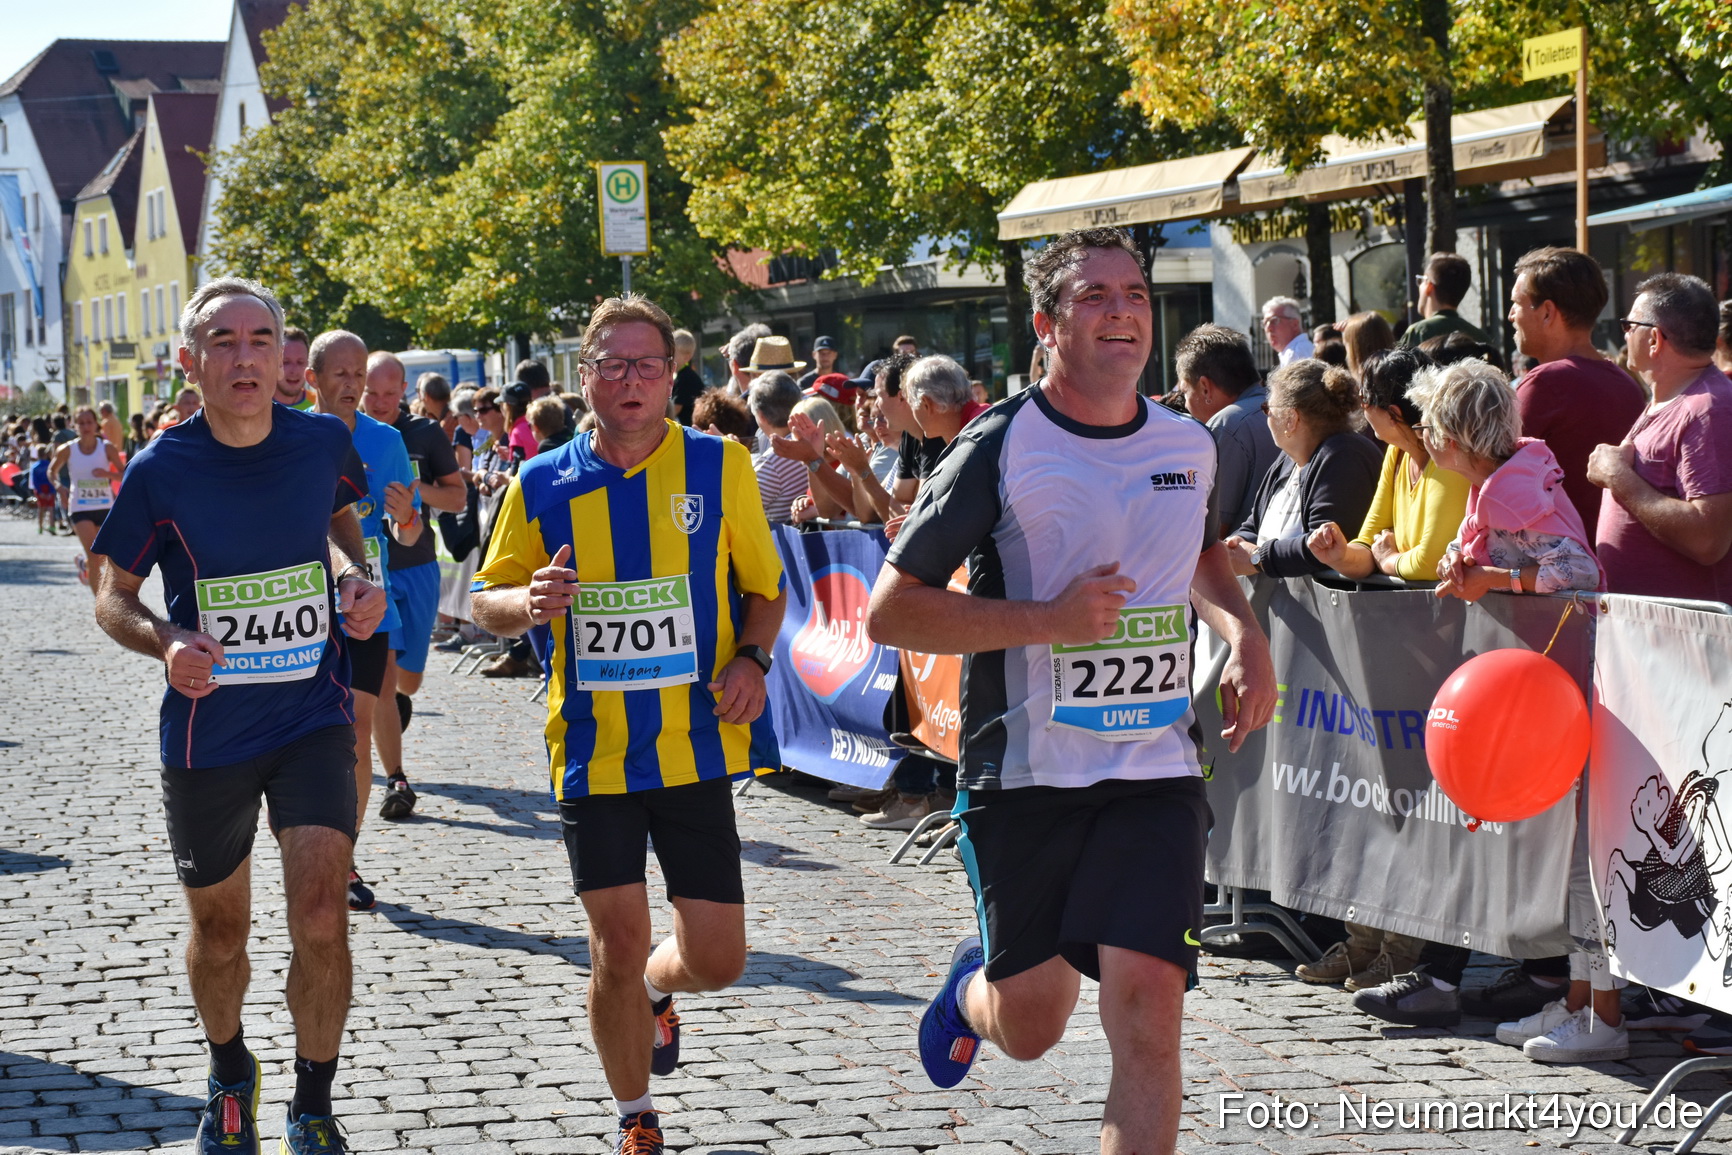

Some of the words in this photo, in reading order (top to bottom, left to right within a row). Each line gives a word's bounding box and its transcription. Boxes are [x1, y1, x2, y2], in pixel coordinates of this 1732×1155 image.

[1534, 45, 1577, 66] Toiletten
[615, 176, 631, 196] H
[552, 475, 579, 487] erima
[1150, 472, 1188, 486] swn
[207, 570, 316, 606] BOCK
[579, 582, 680, 611] BOCK
[216, 604, 318, 647] 2440
[585, 616, 677, 653] 2701
[221, 647, 321, 670] WOLFGANG
[600, 662, 662, 680] Wolfgang
[1071, 652, 1176, 698] 2222
[1102, 708, 1150, 727] UWE
[1296, 687, 1429, 751] INDUSTR
[830, 727, 851, 762] GET
